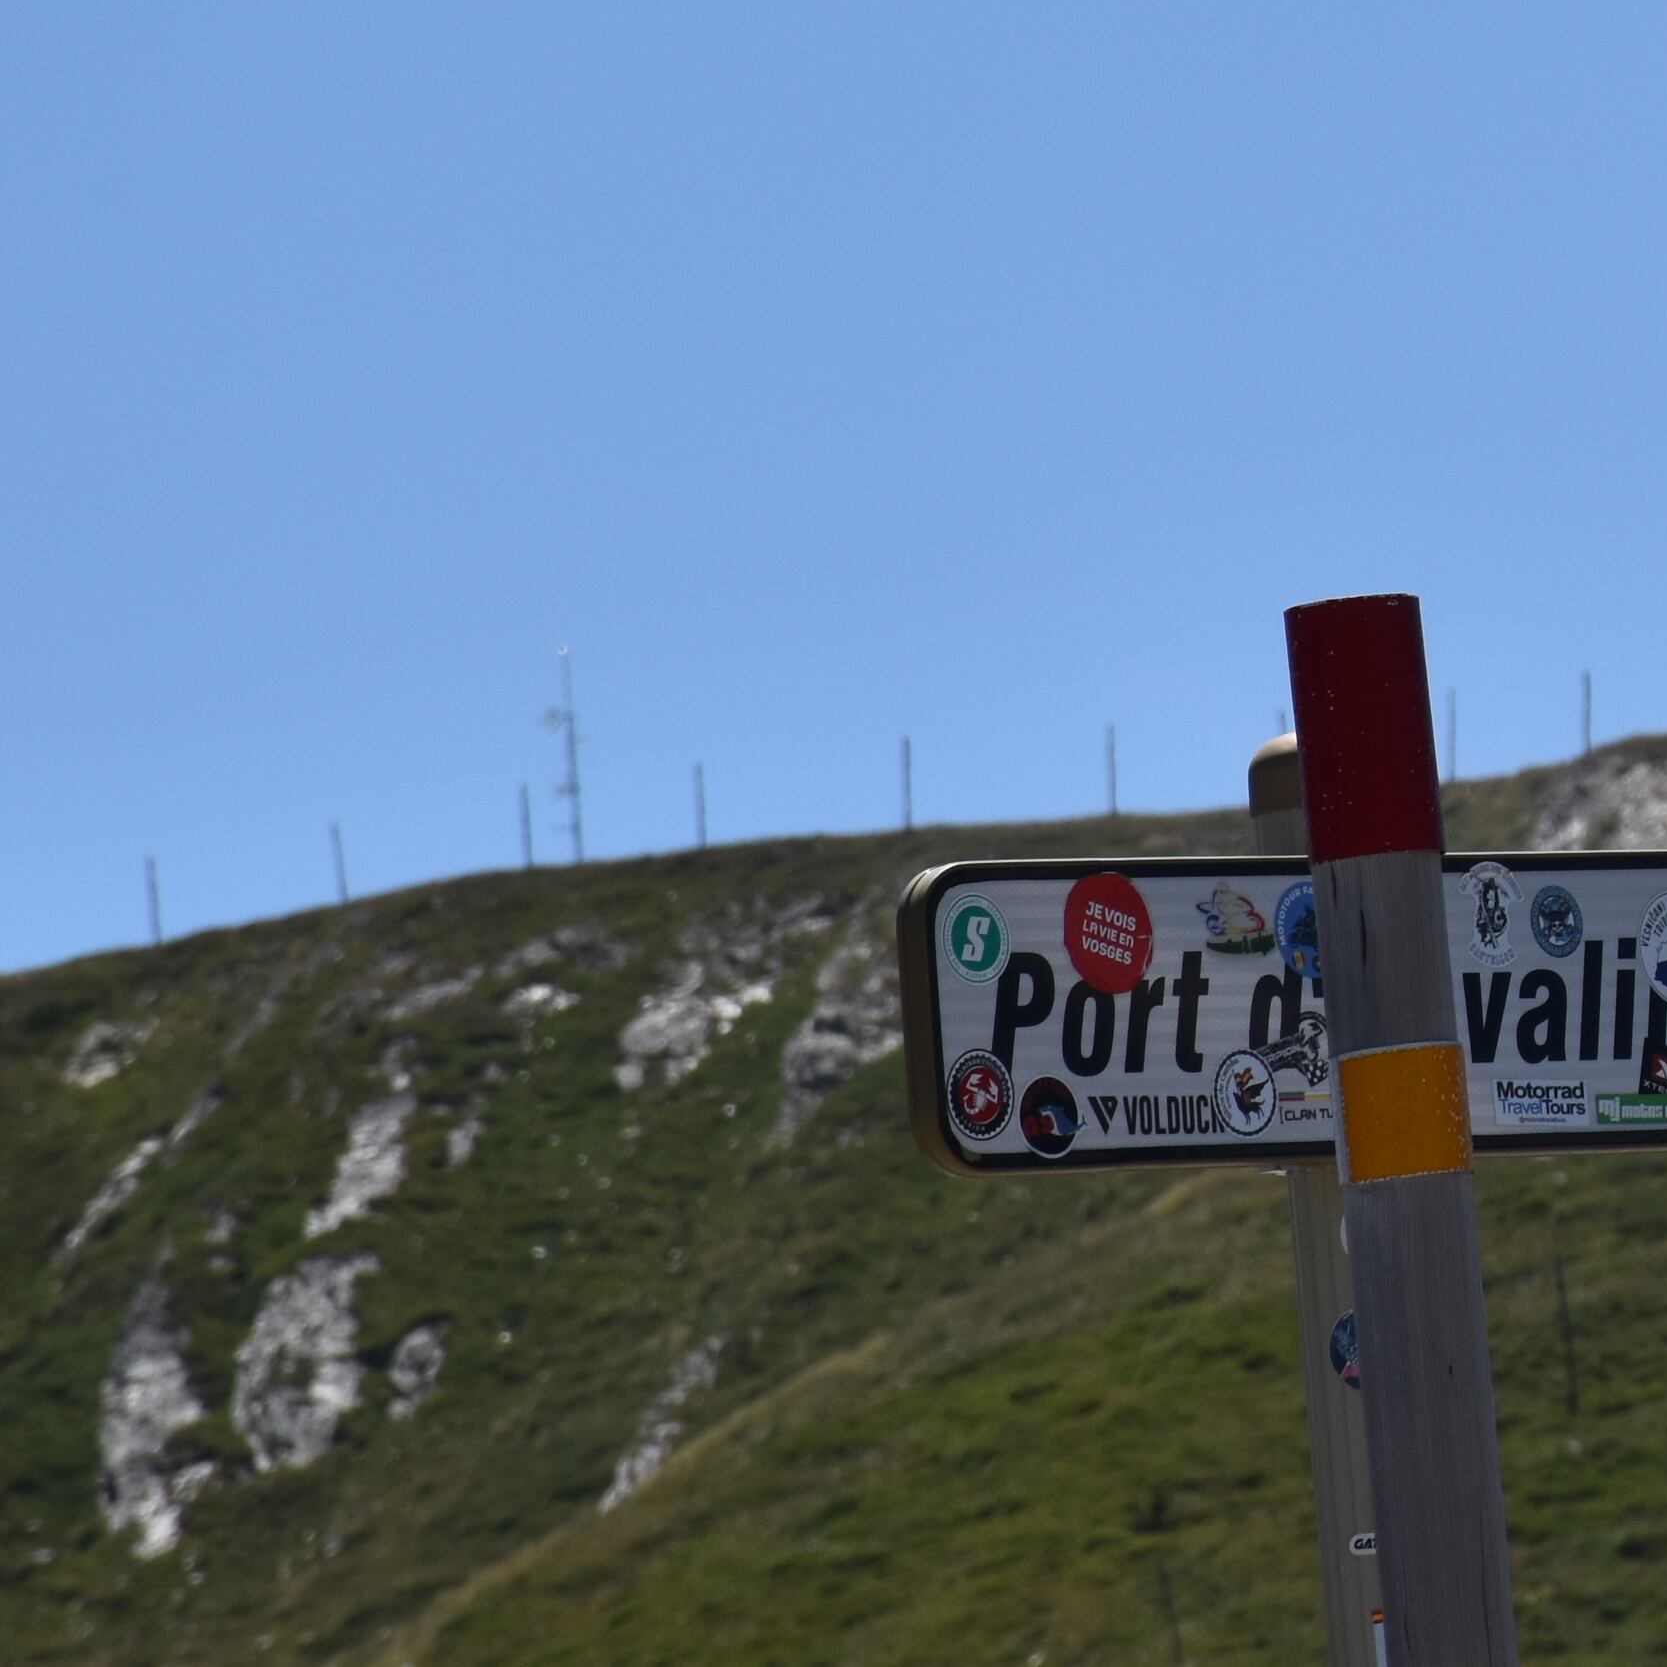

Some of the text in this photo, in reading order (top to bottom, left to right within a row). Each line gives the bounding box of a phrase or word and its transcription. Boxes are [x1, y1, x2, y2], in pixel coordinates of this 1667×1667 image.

[1082, 919, 1098, 935] LA
[1099, 924, 1118, 942] VIE
[1085, 901, 1136, 931] JE VOIS
[961, 916, 991, 962] S
[1082, 935, 1132, 965] VOSGES
[991, 950, 1209, 1077] Port
[1496, 1081, 1585, 1100] Motorrad
[1285, 1109, 1316, 1121] CLAN
